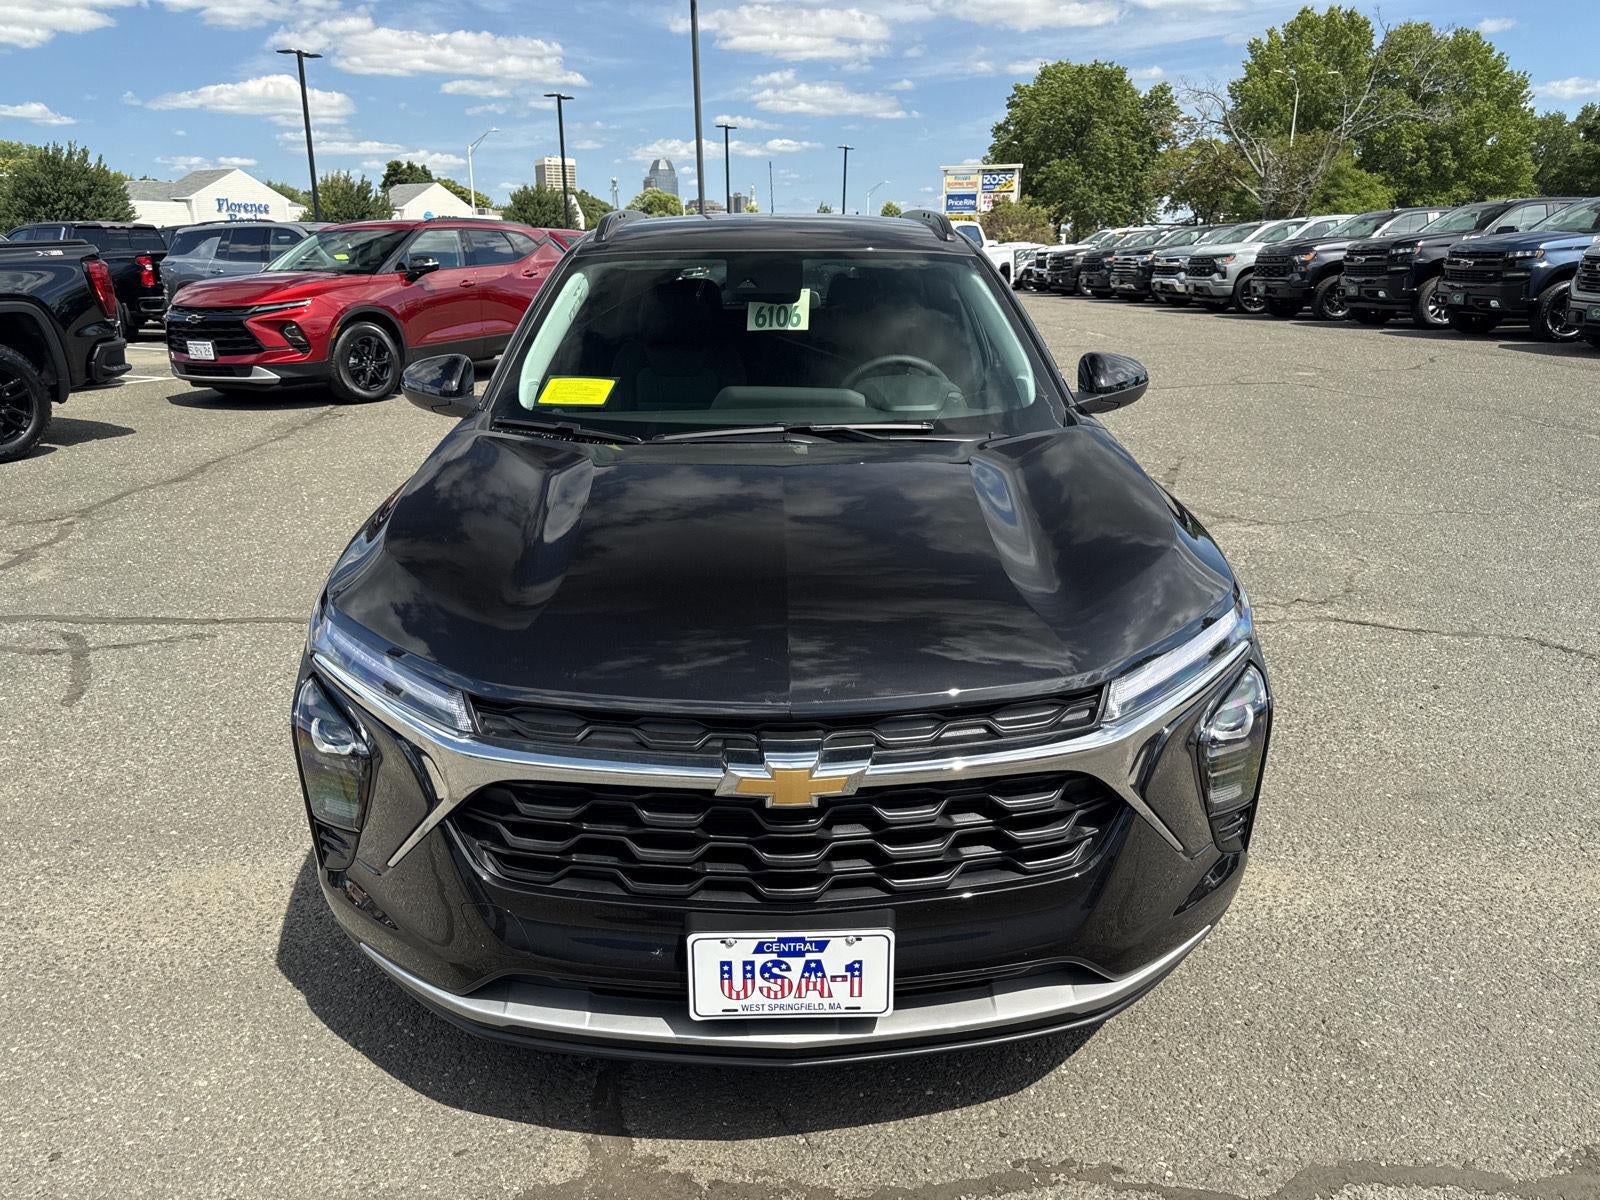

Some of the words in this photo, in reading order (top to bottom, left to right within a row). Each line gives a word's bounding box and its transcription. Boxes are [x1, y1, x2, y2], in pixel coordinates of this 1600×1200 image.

[983, 174, 1014, 185] ROSS
[215, 198, 270, 214] Florence
[755, 305, 801, 328] 6106
[763, 942, 819, 952] CENTRAL
[719, 959, 863, 1000] USA-1
[741, 1003, 766, 1012] WEST
[767, 1003, 827, 1012] SPRINGFIELD,
[828, 1002, 842, 1011] MA
